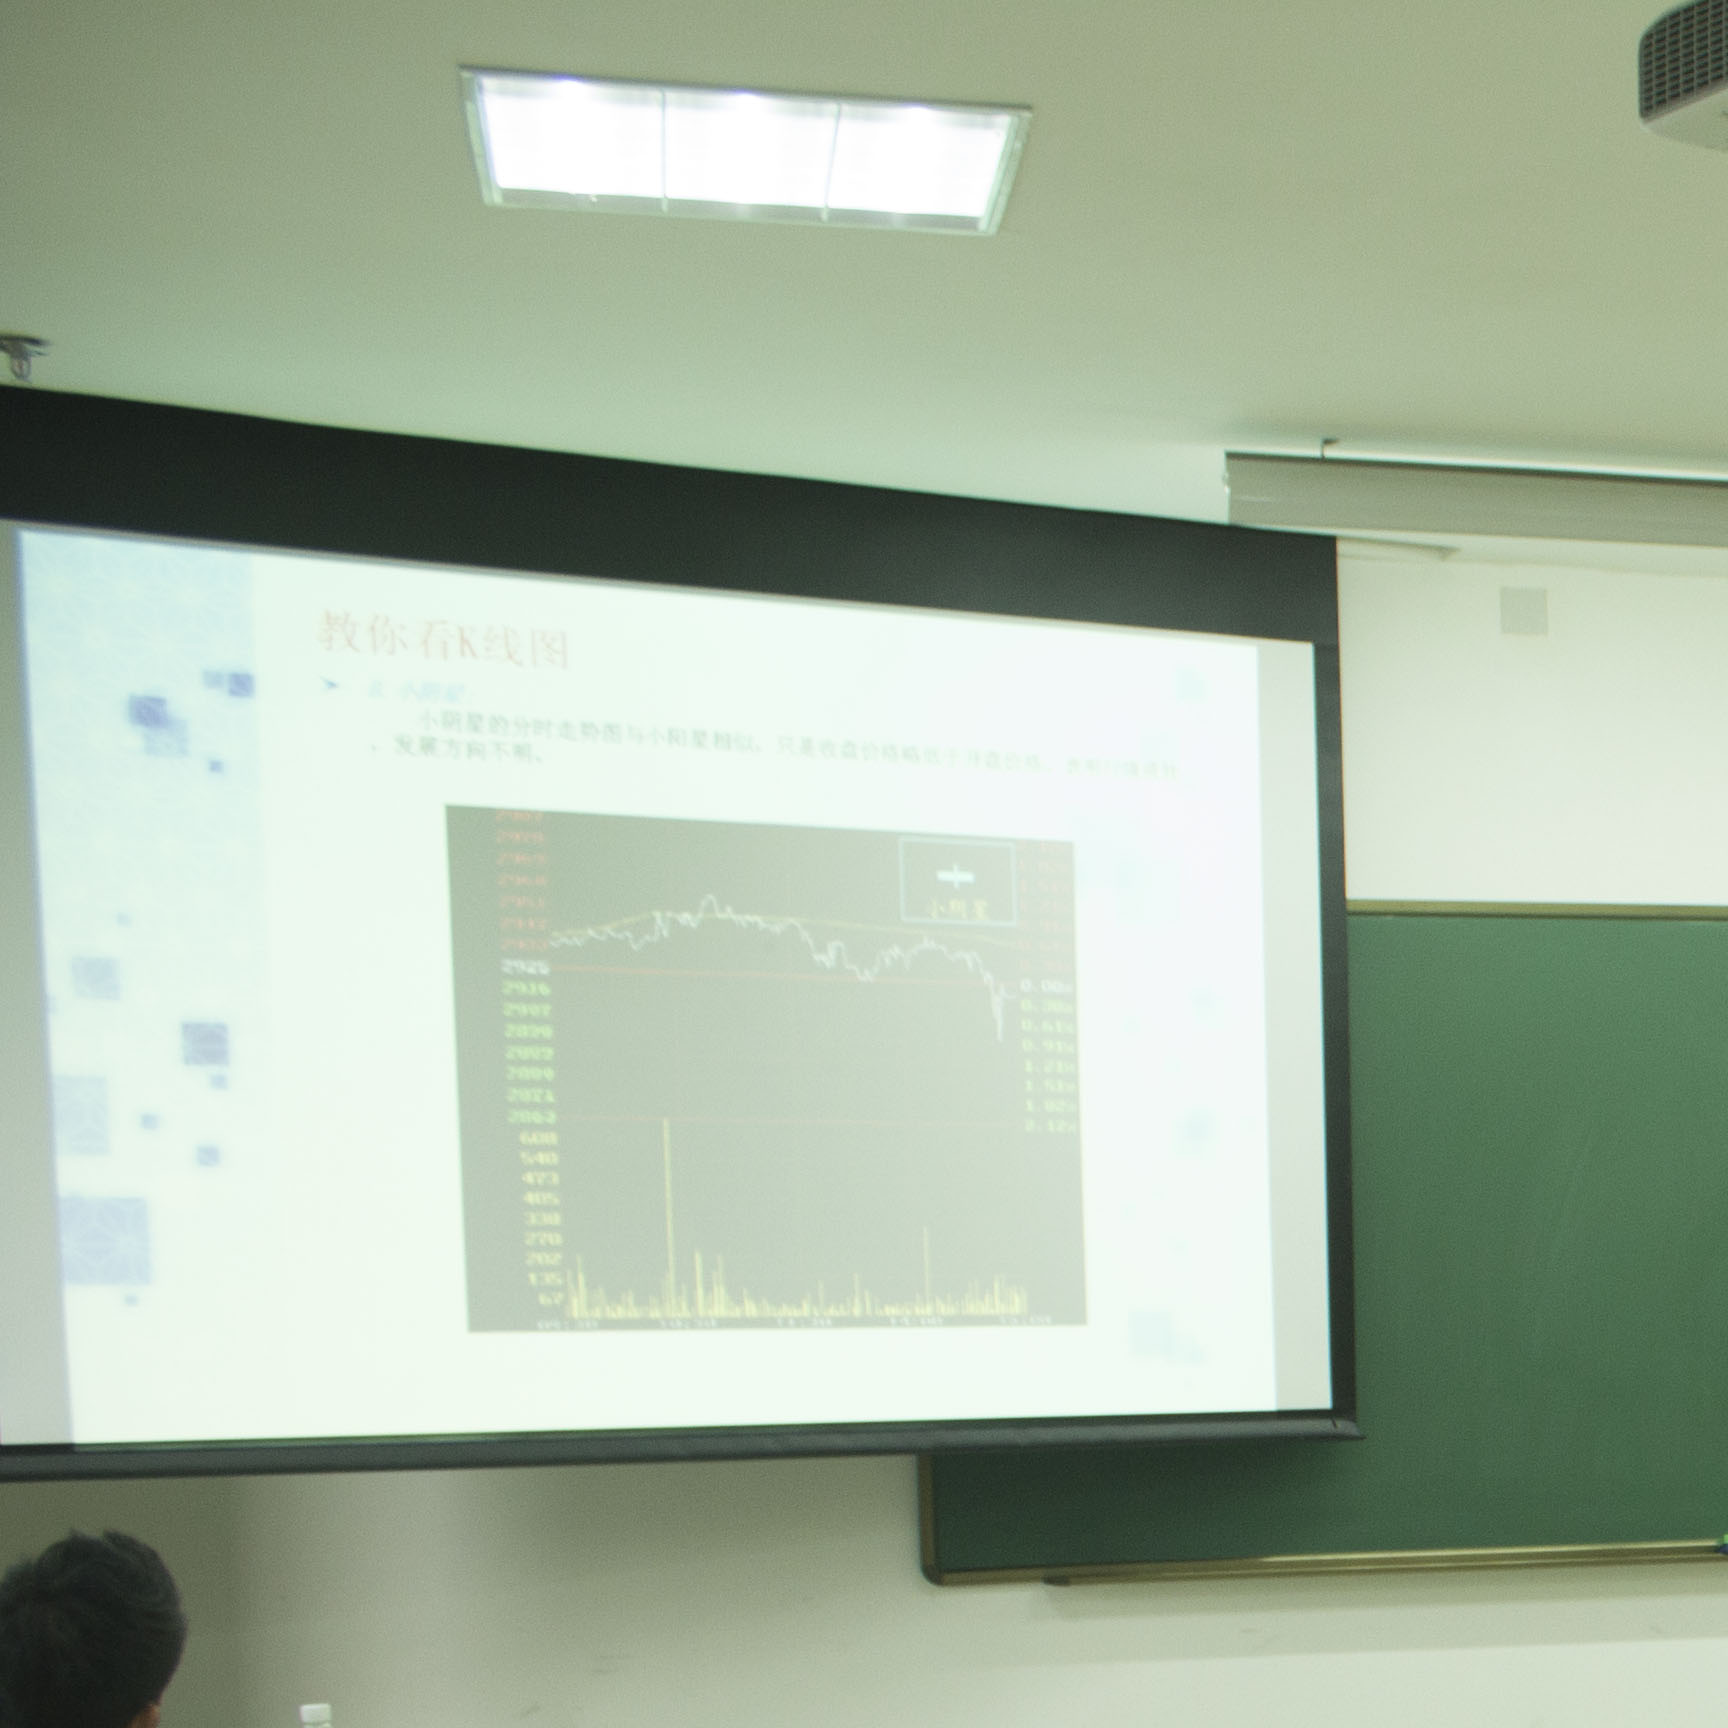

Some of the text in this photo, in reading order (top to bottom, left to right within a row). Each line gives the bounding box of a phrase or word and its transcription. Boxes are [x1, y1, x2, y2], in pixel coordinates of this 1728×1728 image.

[316, 608, 568, 669] 教你看K线图
